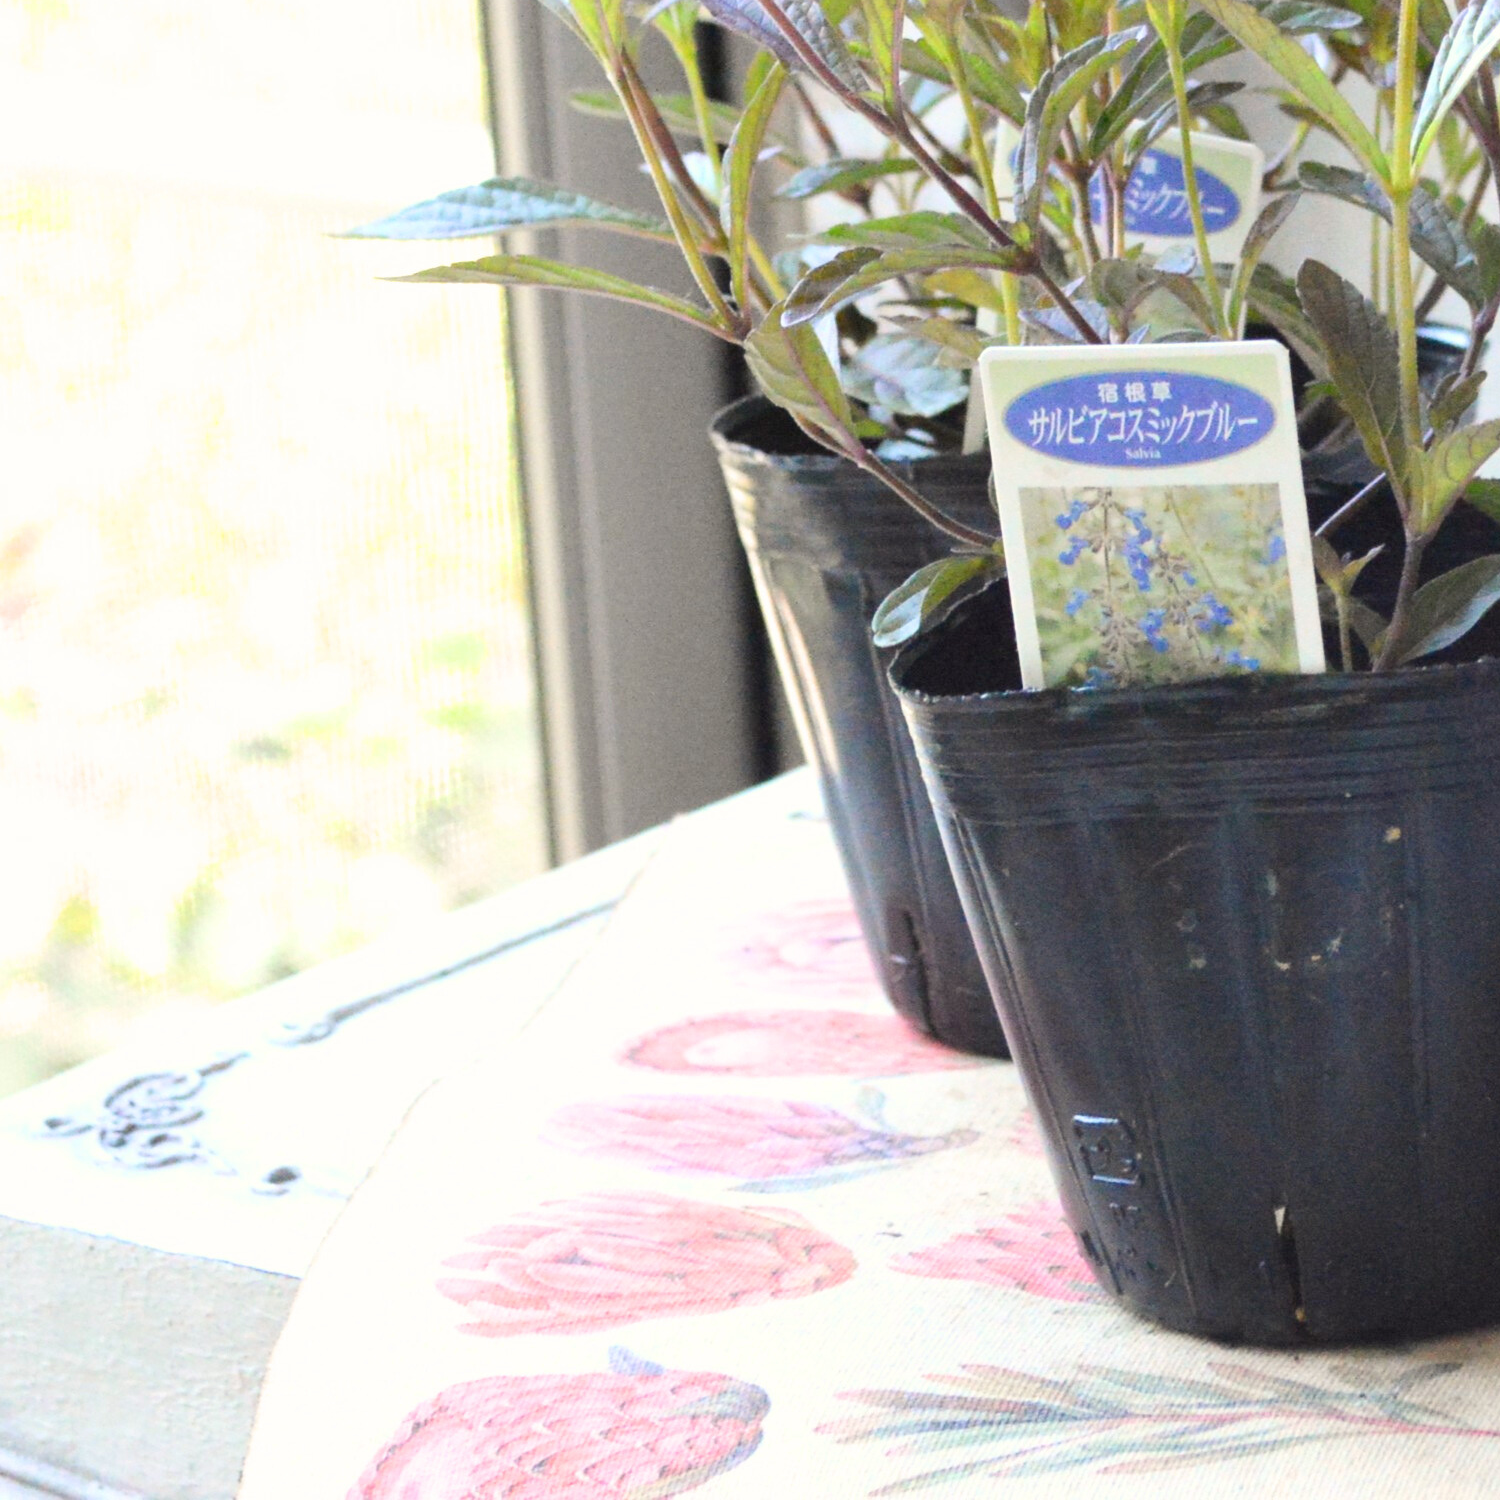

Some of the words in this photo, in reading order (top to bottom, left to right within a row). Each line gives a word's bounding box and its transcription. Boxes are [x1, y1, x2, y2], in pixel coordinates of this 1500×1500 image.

[1098, 381, 1172, 403] 宿根草
[1028, 401, 1258, 446] サルビアコスミックブルー
[1125, 448, 1161, 460] Salvia
